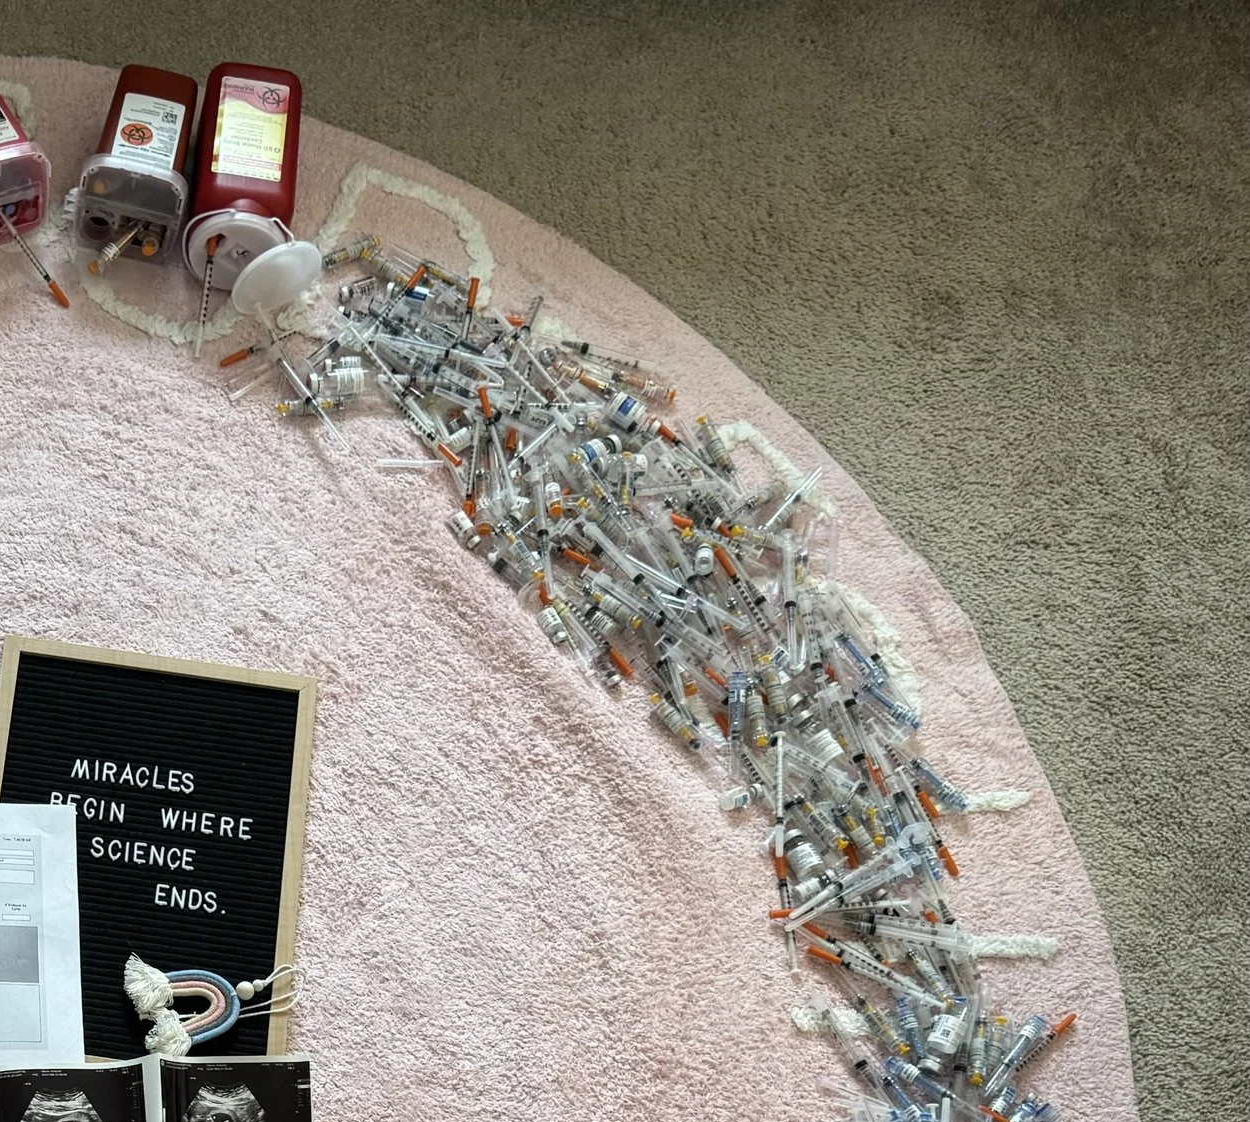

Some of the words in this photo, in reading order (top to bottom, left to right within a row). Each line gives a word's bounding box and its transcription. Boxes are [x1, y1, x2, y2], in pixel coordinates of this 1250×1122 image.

[70, 759, 194, 794] MIRACLES
[161, 808, 253, 840] WHERE
[90, 837, 197, 871] SCIENCE
[154, 883, 226, 915] ENDS.
